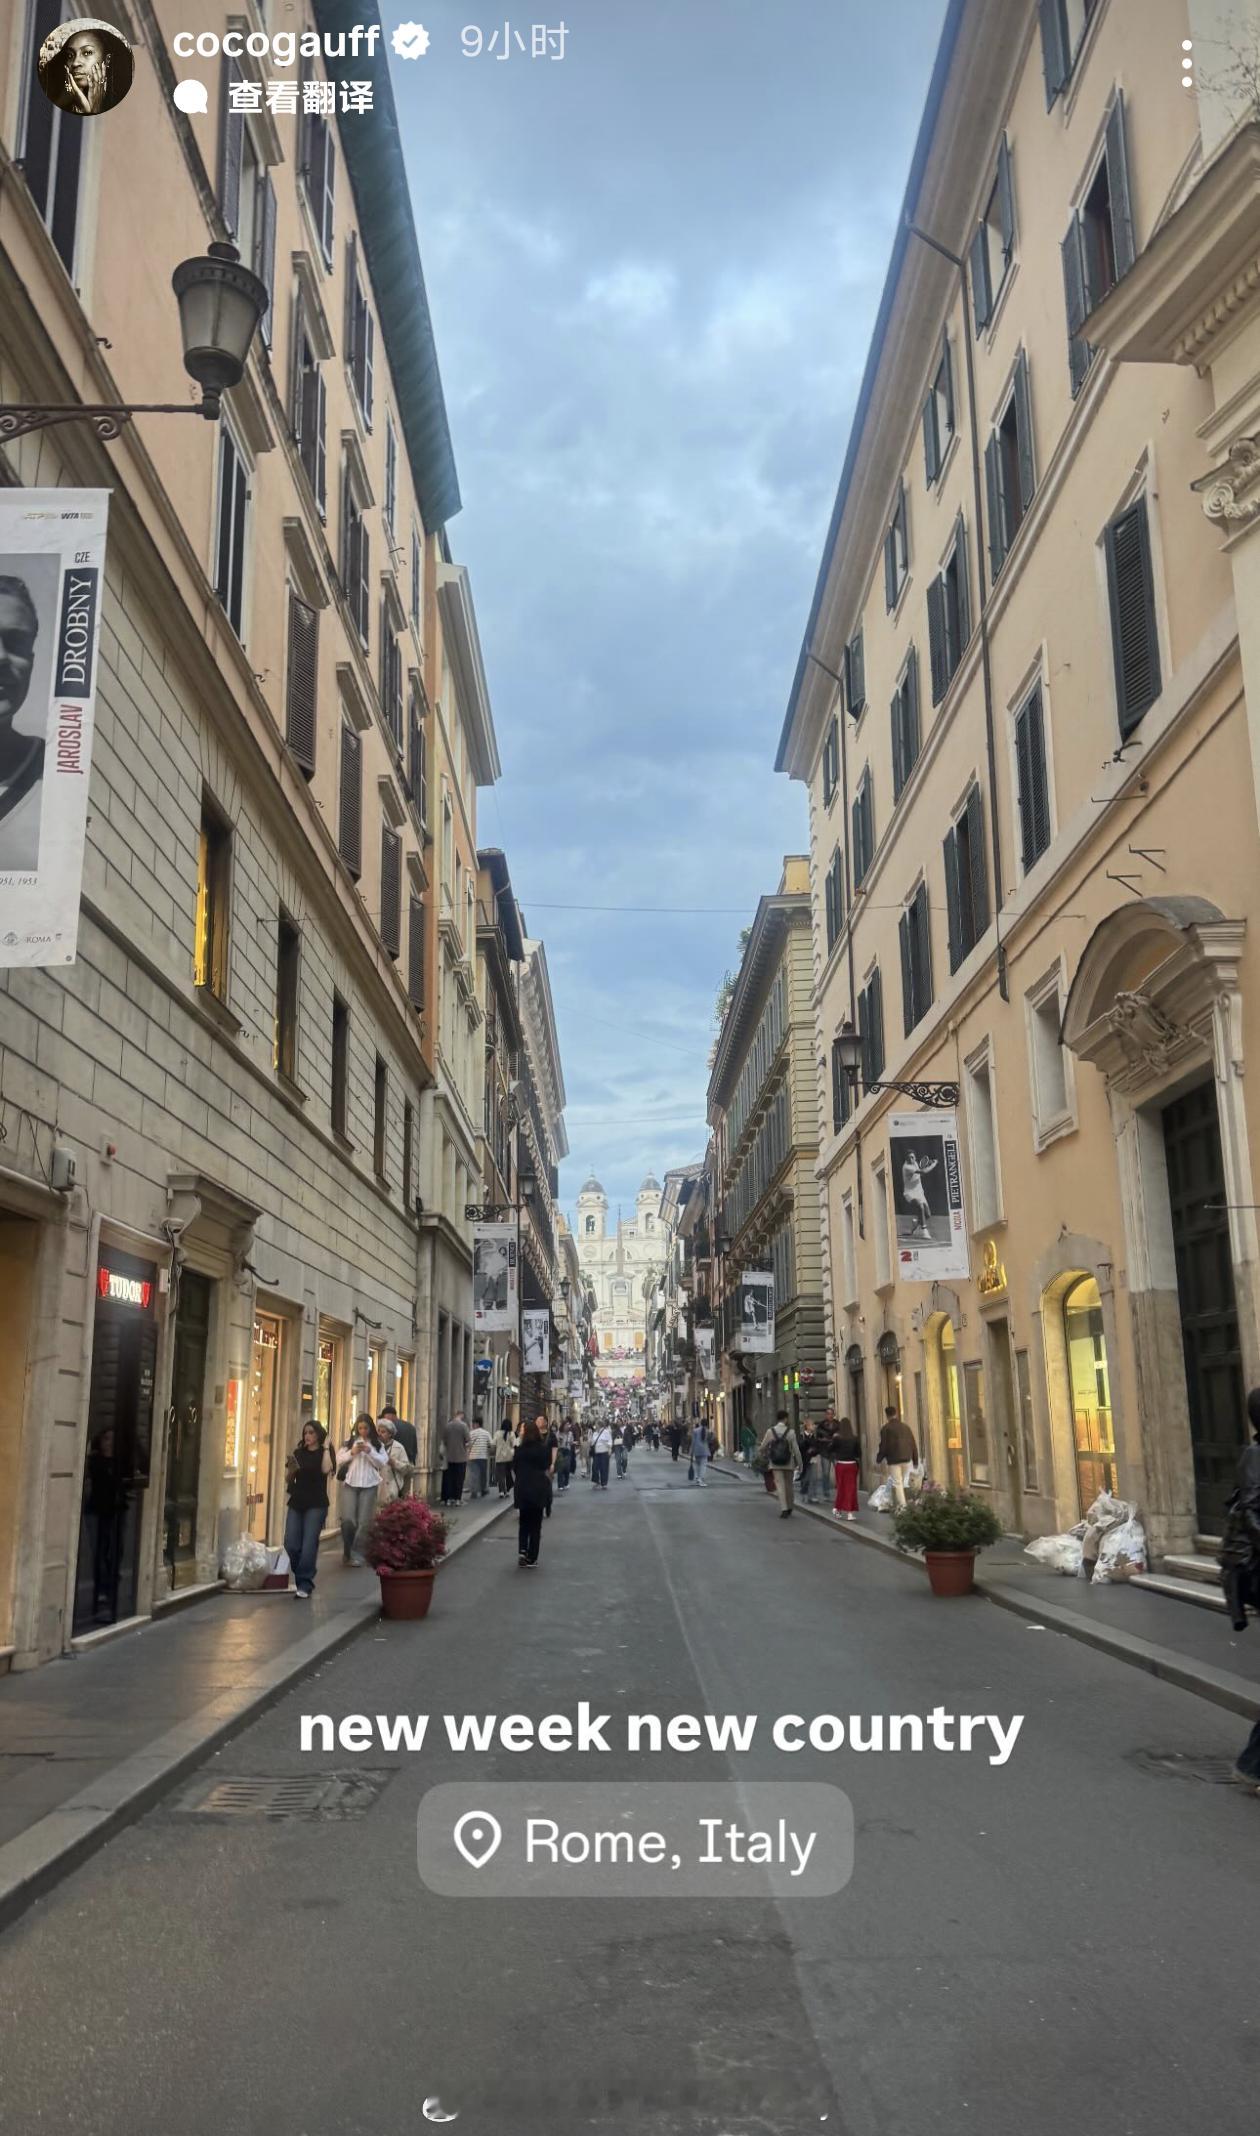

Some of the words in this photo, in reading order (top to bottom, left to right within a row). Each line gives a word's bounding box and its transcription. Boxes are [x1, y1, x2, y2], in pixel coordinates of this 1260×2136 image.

[74, 551, 91, 564] CZE
[61, 576, 92, 685] DROBNY
[56, 704, 84, 775] JAROSLAV
[946, 1143, 960, 1203] PIETRANGELI
[900, 1250, 912, 1262] 2
[109, 1273, 142, 1304] TUDOR
